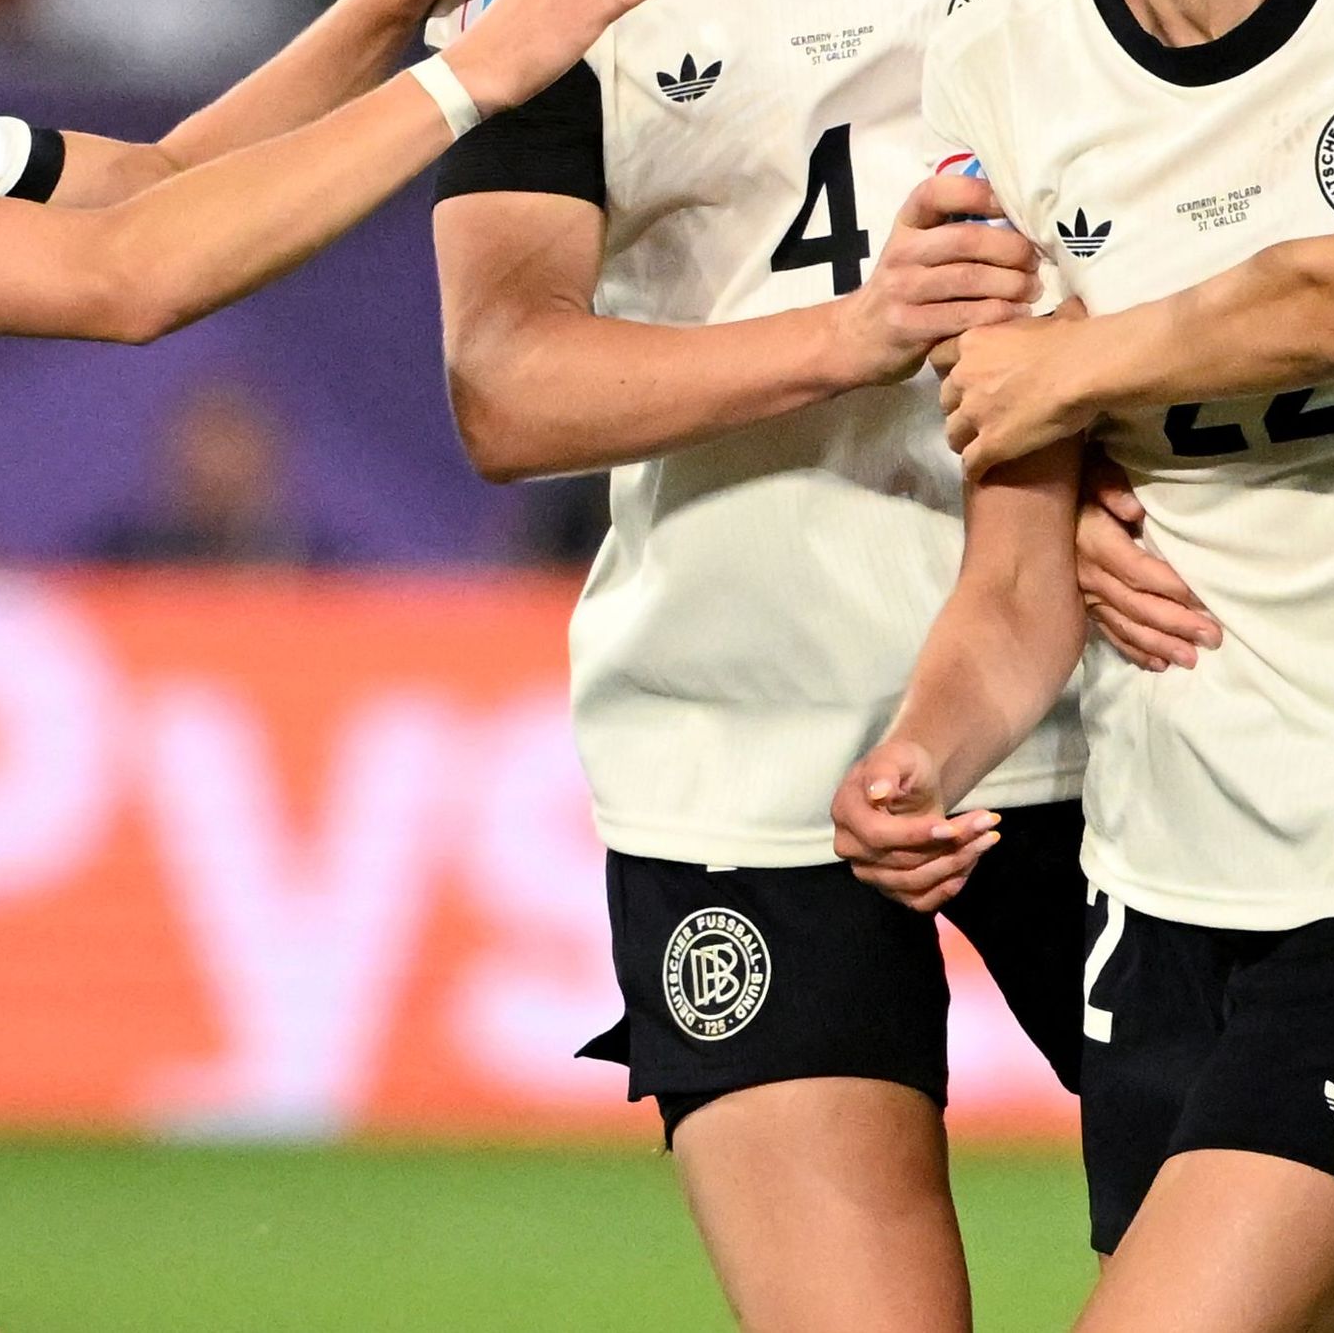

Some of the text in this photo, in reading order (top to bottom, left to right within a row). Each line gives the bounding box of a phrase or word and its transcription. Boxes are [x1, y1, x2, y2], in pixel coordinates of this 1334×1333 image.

[769, 122, 870, 297] 4
[1176, 195, 1217, 214] GERMANY
[1228, 184, 1262, 202] POLAND
[1191, 199, 1250, 222] 04 JULY 2025
[1213, 211, 1247, 228] GALLEN
[668, 926, 696, 1027] DEUTSCHER
